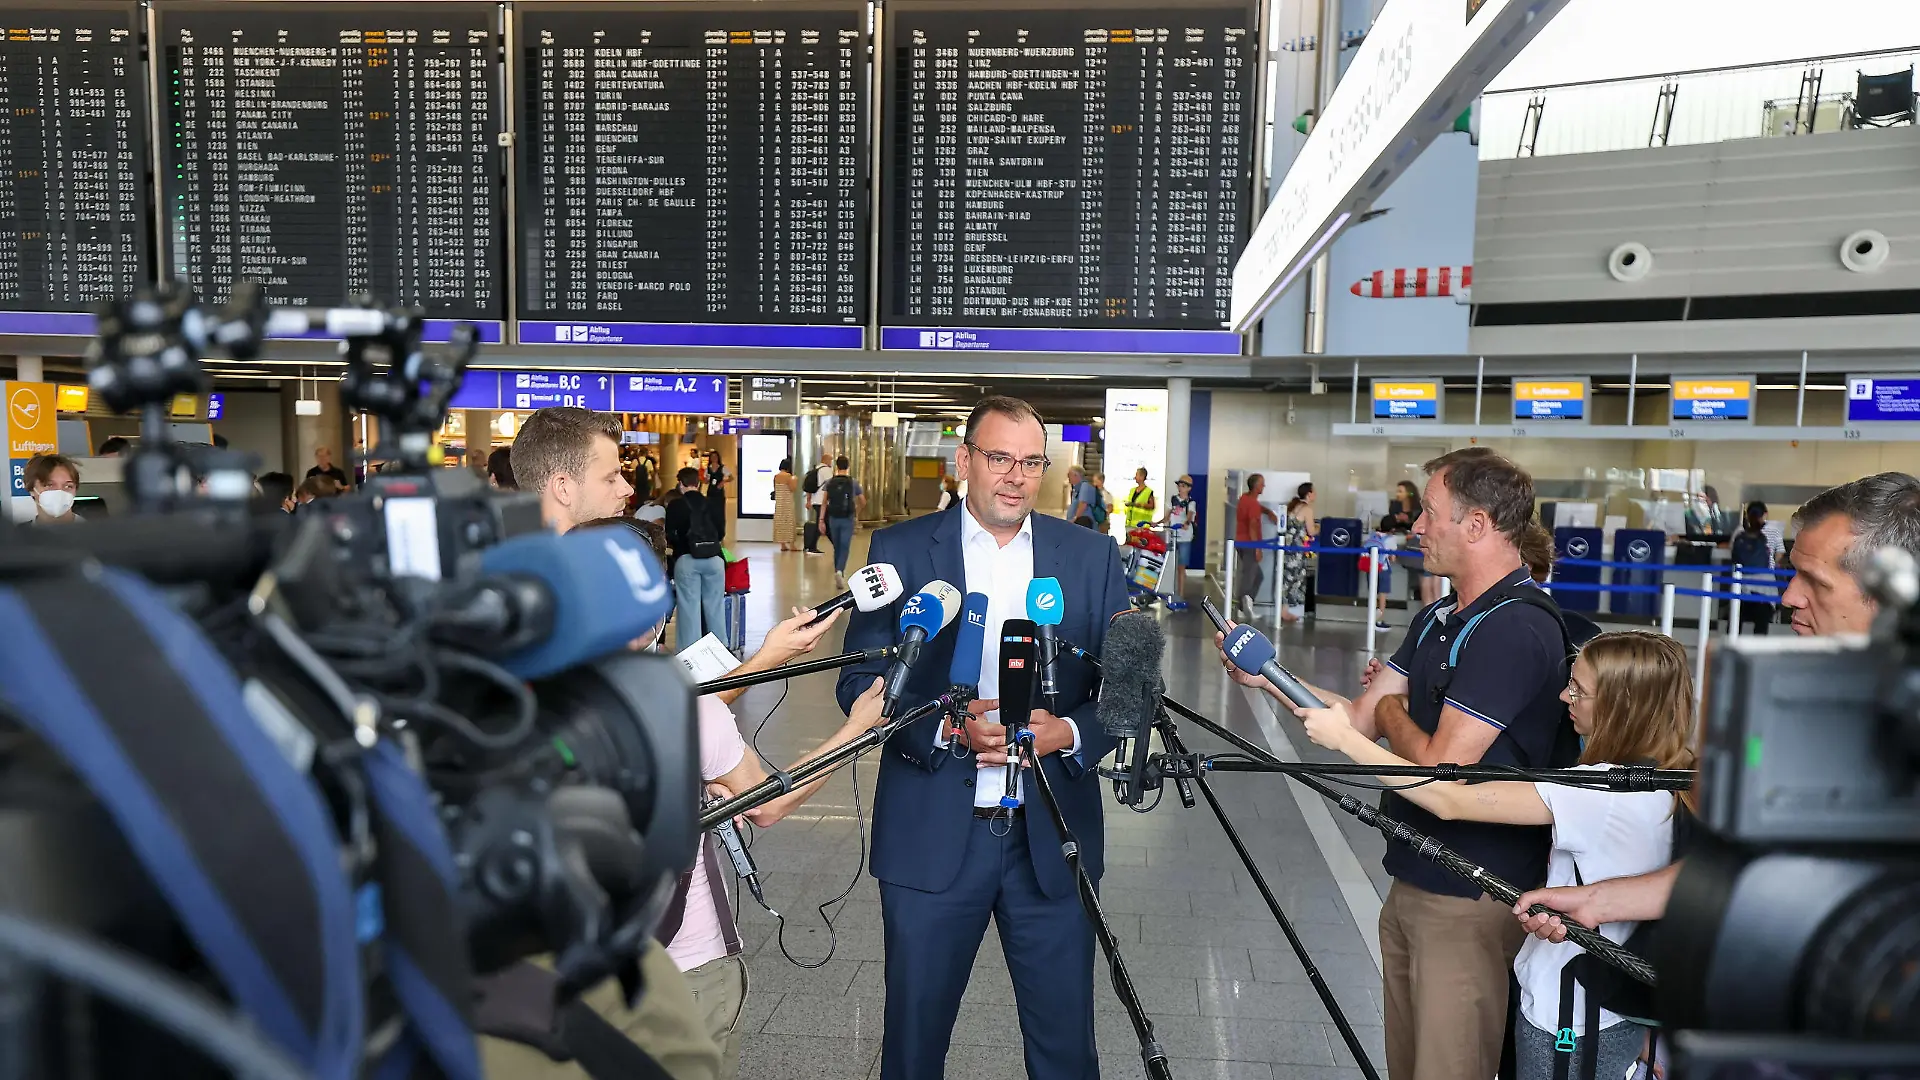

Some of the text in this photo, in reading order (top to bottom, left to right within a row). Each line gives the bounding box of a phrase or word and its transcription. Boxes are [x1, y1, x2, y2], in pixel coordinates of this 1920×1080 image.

[595, 49, 621, 57] KOELN
[968, 48, 1074, 56] NUERNBERG-WUERZBURG
[234, 58, 249, 66] NEW
[631, 60, 700, 68] HBF-GOETTINGE
[914, 60, 925, 68] EN
[968, 59, 990, 68] LINZ
[595, 70, 616, 78] GRAN
[968, 70, 1079, 78] HAMBURG-GOETTINGEN-H
[236, 79, 275, 87] ISTANBUL
[595, 81, 664, 89] FUERTEVENTURA
[968, 81, 1078, 89] AACHEN HBF-KOELN HBF
[967, 92, 995, 100] PUNTA
[967, 103, 1012, 111] SALZBURG
[272, 111, 292, 119] CITY
[595, 113, 622, 121] TUNIS
[967, 114, 1017, 122] CHICAGO-O
[1022, 114, 1044, 122] HARE
[236, 121, 257, 129] GRAN
[967, 125, 1055, 133] MAILAND-MALPENSA
[913, 136, 924, 144] LH
[967, 136, 1022, 144] LYON-SAINT
[1027, 136, 1066, 144] EXUPERY
[237, 142, 258, 150] WIEN
[595, 145, 616, 153] GENF
[596, 177, 685, 185] WASHINGTON-DULLES
[659, 188, 674, 196] HBF
[965, 201, 1004, 209] HAMBURG
[597, 219, 632, 227] FLORENZ
[965, 233, 1008, 241] BRUESSEL
[596, 240, 638, 248] SINGAPUR
[964, 255, 1073, 263] DRESDEN-LEIPZIG-ERFU
[964, 265, 1013, 273] LUXEMBURG
[597, 292, 617, 300] FARO
[963, 297, 1028, 305] DORTMUND-DUS
[1034, 298, 1071, 306] HBF-KOE
[1001, 308, 1071, 316] BHF-OSNABRUEC
[589, 326, 610, 334] Abflug
[956, 332, 976, 340] Abflug
[559, 375, 580, 390] B,C
[675, 378, 696, 393] A,Z
[13, 441, 54, 451] Lufthansa
[862, 566, 884, 599] FFH
[969, 610, 982, 622] hr
